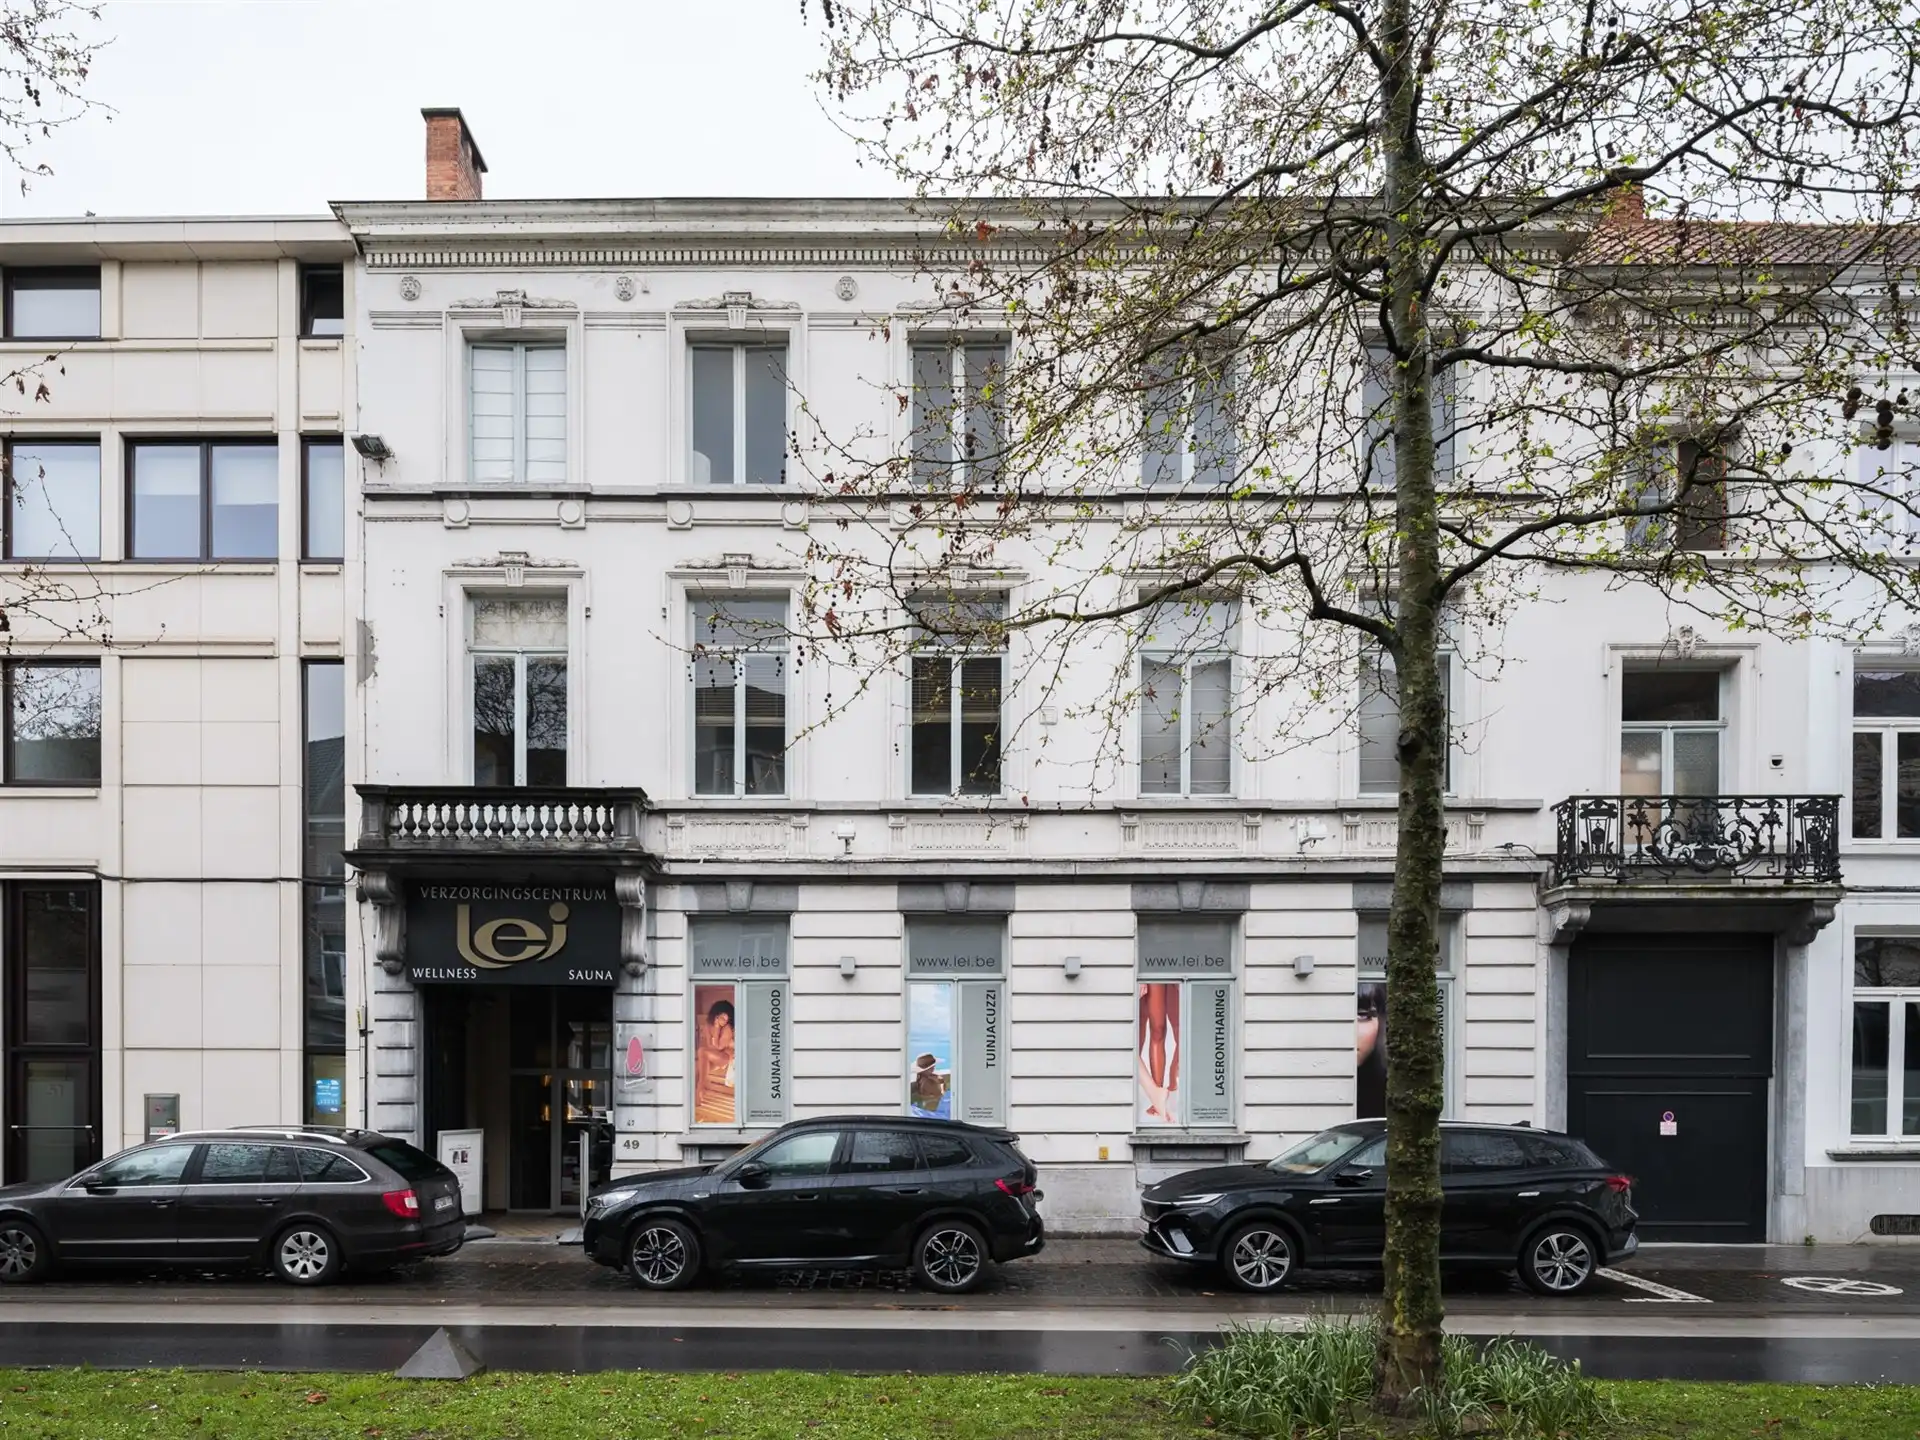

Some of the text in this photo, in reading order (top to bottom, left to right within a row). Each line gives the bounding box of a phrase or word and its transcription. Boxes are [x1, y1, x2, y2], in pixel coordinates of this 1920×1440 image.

[420, 886, 607, 901] VERZORGINGSCENTRUM
[701, 955, 781, 968] www.lei.be
[915, 955, 996, 968] www.lei.be
[1144, 955, 1225, 968] www.lei.be
[412, 967, 477, 979] WELLNESS
[568, 969, 613, 981] SAUNA
[985, 989, 996, 1069] TUINJACUZZI
[771, 989, 781, 1099] SAUNA-INFRAROOD
[1215, 989, 1226, 1096] LASERONTHARING
[623, 1139, 640, 1150] 49
